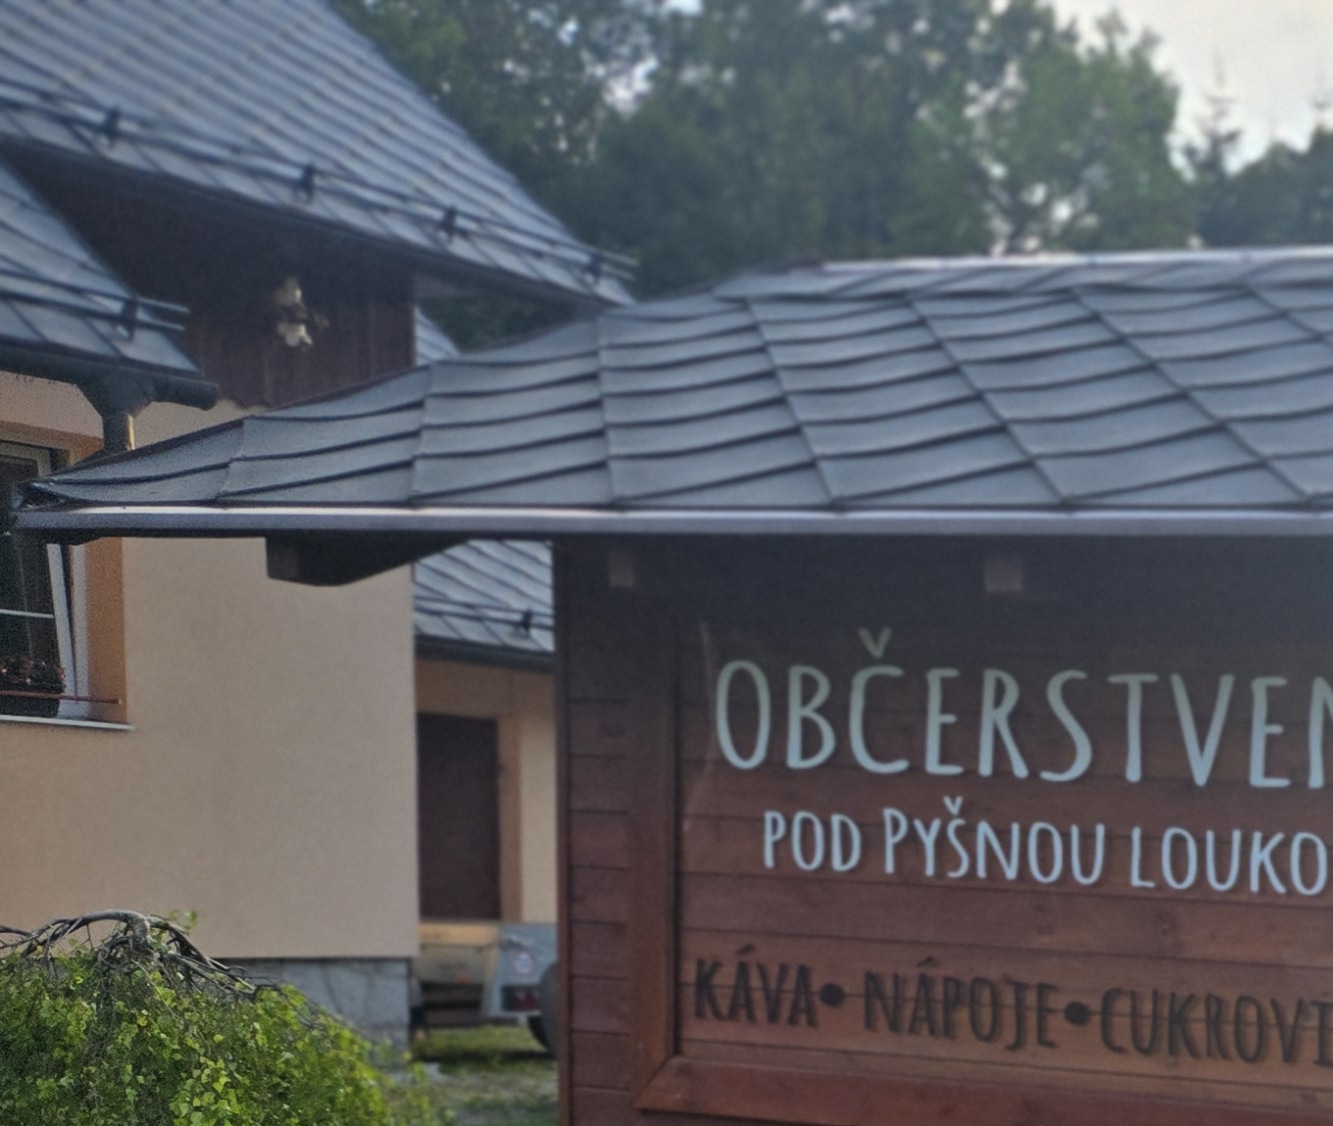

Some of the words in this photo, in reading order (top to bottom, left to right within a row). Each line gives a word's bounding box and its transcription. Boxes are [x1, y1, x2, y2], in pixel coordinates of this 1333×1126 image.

[763, 810, 862, 873] POD
[882, 796, 1106, 886] PYŠNOU
[693, 943, 820, 1030] KÁVA
[862, 955, 1062, 1051] NÁPOJE
